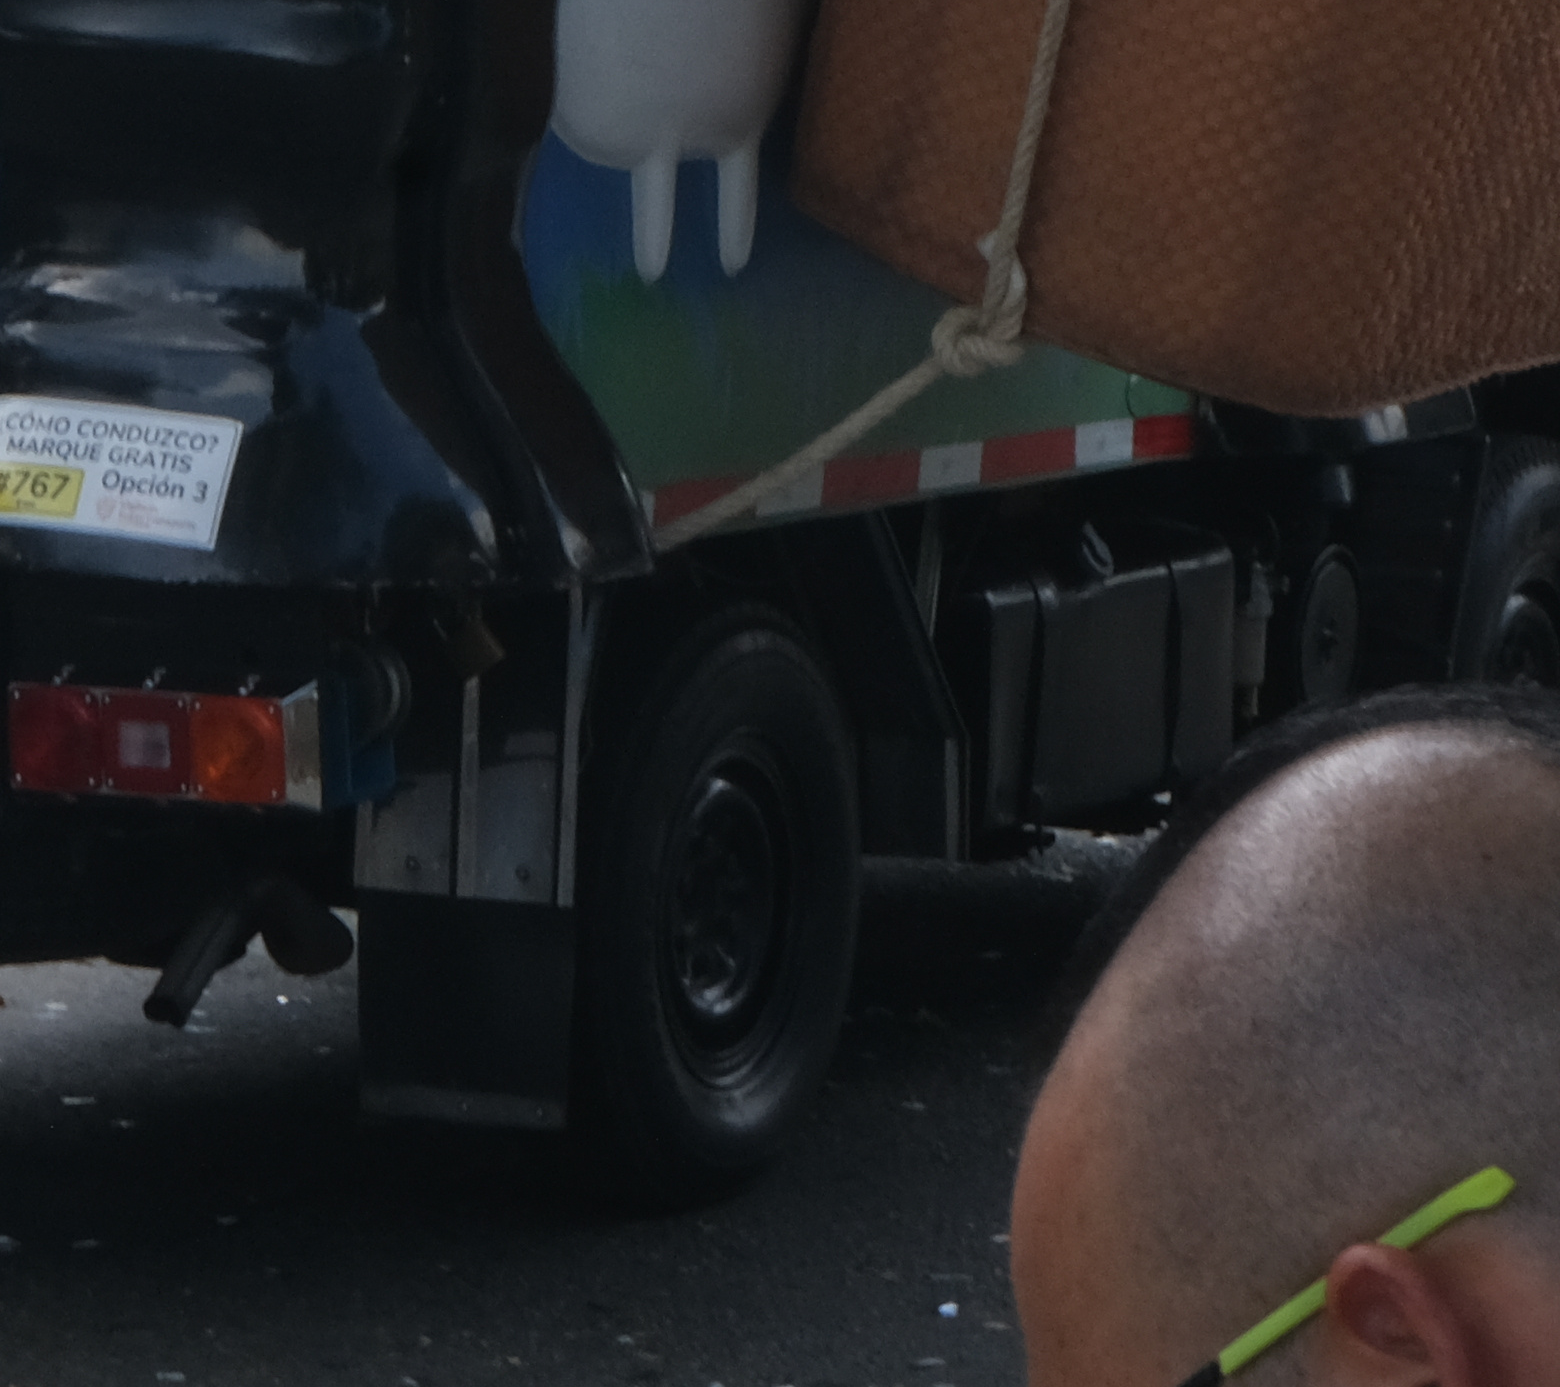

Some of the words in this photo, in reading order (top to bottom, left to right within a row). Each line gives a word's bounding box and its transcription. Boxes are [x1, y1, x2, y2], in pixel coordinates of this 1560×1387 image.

[5, 435, 101, 462] MARQUE
[107, 445, 193, 473] GRATIS
[76, 418, 220, 455] CONDUZCO?
[101, 468, 185, 500] Opción
[192, 480, 209, 504] 3
